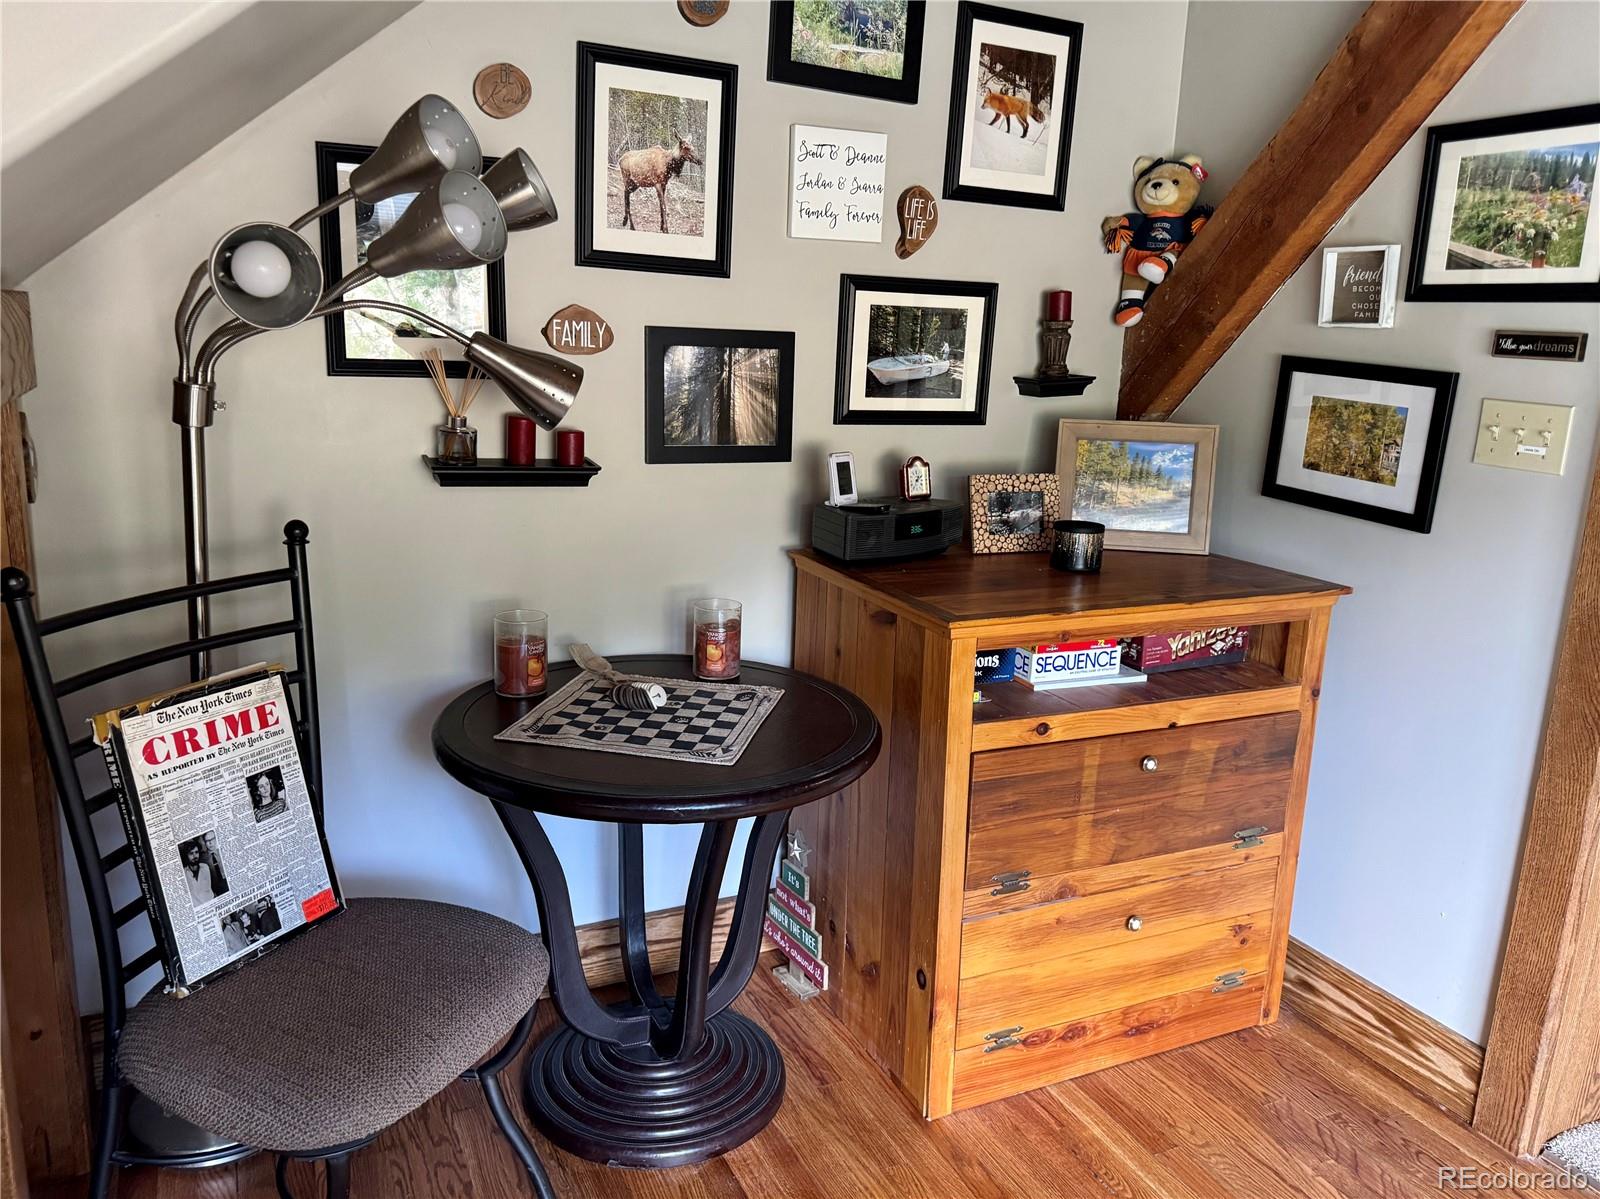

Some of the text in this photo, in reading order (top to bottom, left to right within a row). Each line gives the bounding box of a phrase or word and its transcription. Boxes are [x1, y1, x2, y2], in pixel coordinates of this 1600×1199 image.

[797, 139, 886, 167] Scott & Deanne
[796, 172, 834, 191] Jordan
[838, 175, 847, 191] &
[796, 199, 882, 230] Family Forever
[904, 197, 937, 221] LIFE IS
[1343, 264, 1384, 288] friend
[1352, 285, 1381, 294] BECOM
[1351, 302, 1380, 310] CHOSE
[552, 318, 607, 348] FAMILY
[1533, 341, 1575, 353] dreams
[1035, 650, 1118, 674] SEQUENCE
[156, 688, 253, 724] The New York Times
[142, 700, 280, 765] CRIME
[102, 741, 122, 789] RIME
[146, 773, 158, 781] AS
[161, 756, 204, 777] REPORTED
[206, 752, 216, 760] BY
[217, 747, 231, 756] The
[231, 742, 247, 752] New
[247, 735, 264, 748] York
[264, 728, 285, 740] Times
[787, 871, 800, 889] It's
[776, 887, 811, 922] not what's
[769, 902, 789, 930] UNDER
[789, 916, 801, 939] THE
[773, 930, 790, 953] who's
[790, 947, 815, 975] around
